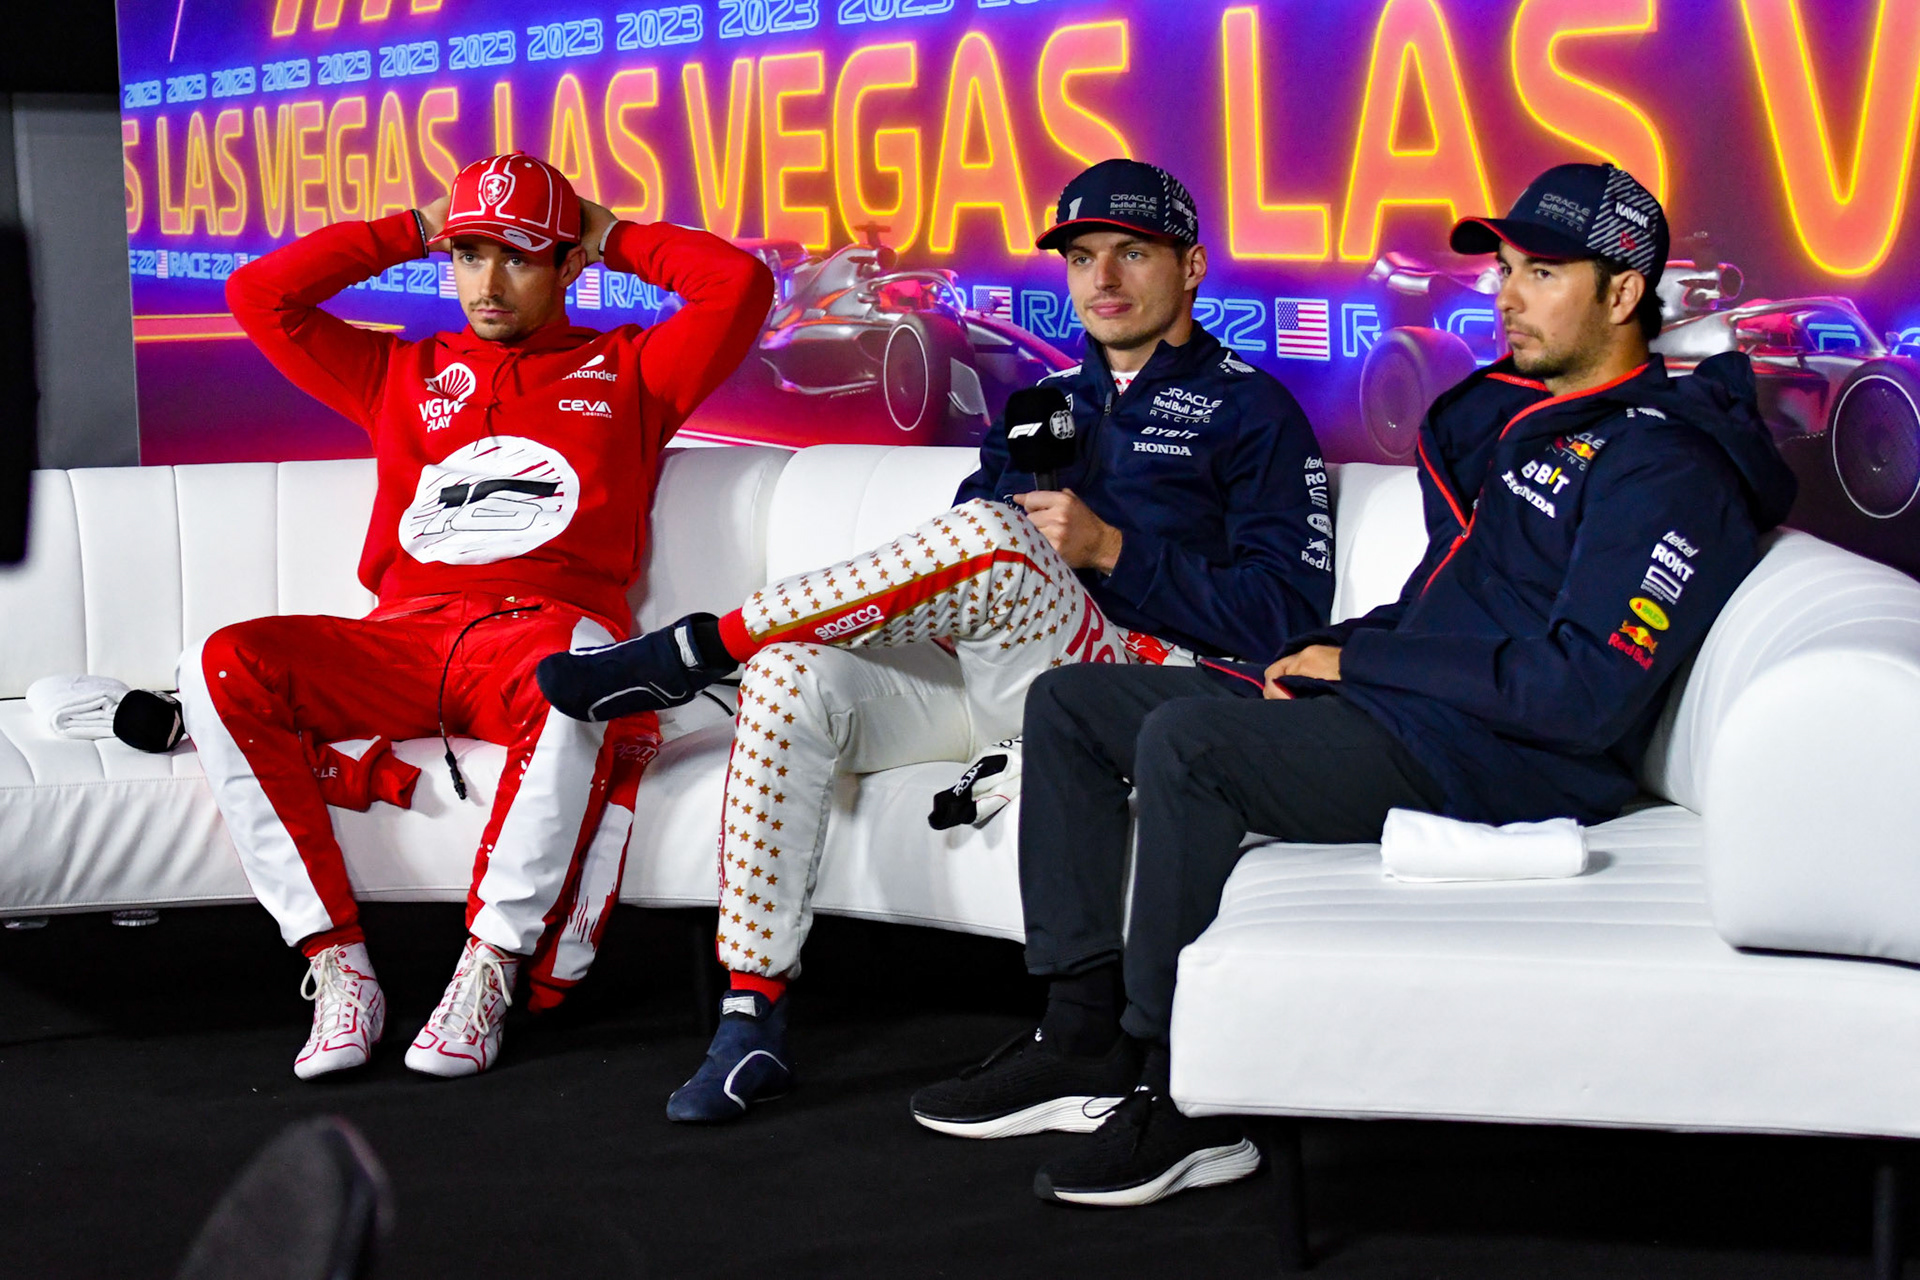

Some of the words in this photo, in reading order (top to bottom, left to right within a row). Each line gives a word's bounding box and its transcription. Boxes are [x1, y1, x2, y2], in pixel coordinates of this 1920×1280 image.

[125, 80, 162, 108] 2023
[166, 73, 207, 103] 2023
[212, 66, 256, 98] 2023
[262, 59, 310, 91] 2023
[317, 50, 371, 85] 2023
[379, 40, 439, 79] 2023
[448, 30, 516, 70] 2023
[527, 18, 603, 61] 2023
[616, 4, 702, 51] 2023
[719, 0, 819, 39] 2023
[156, 110, 247, 236] LAS
[254, 87, 459, 239] VEGAS
[682, 19, 1135, 256] VEGAS
[1221, 0, 1667, 263] LAS
[1110, 194, 1158, 205] ORACLE
[1542, 193, 1591, 217] ORACLE
[1615, 201, 1650, 229] KAVAK
[169, 251, 211, 280] RACE
[406, 262, 438, 295] 22
[418, 397, 468, 422] VGW
[1149, 409, 1211, 425] RACING
[427, 415, 452, 433] PLAY
[1140, 426, 1199, 439] BYBIT
[1133, 441, 1192, 456] HONDA
[1501, 470, 1556, 519] HONDA
[1662, 530, 1699, 558] telcel
[1651, 542, 1695, 582] ROKT
[815, 604, 883, 640] sparco
